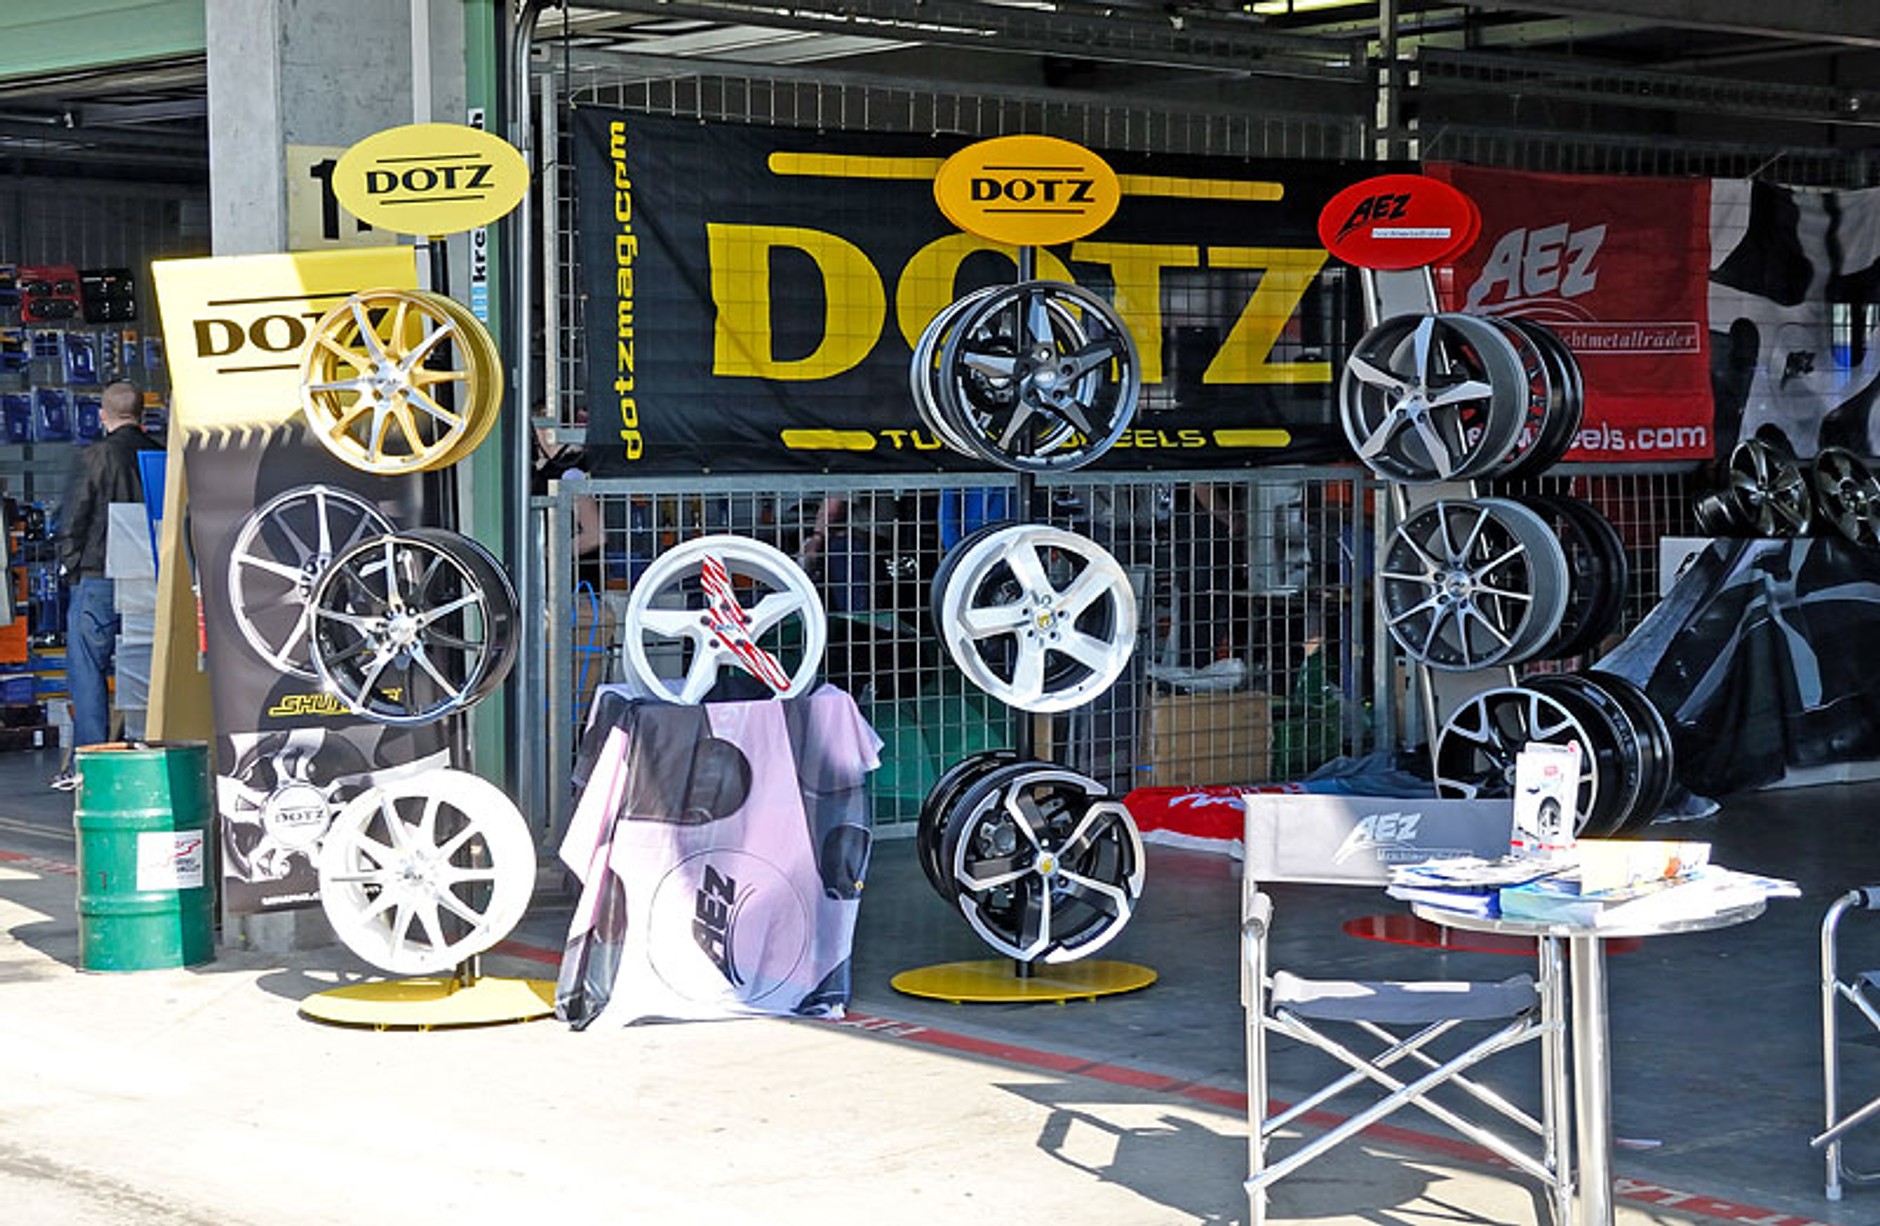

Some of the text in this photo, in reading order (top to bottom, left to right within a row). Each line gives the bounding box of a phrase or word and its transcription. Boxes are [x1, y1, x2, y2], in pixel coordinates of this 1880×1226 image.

[366, 164, 495, 194] DOTZ
[971, 178, 1095, 203] DOTZ
[1466, 223, 1607, 312] AEZ
[193, 307, 389, 358] DO
[691, 864, 739, 988] AEZ
